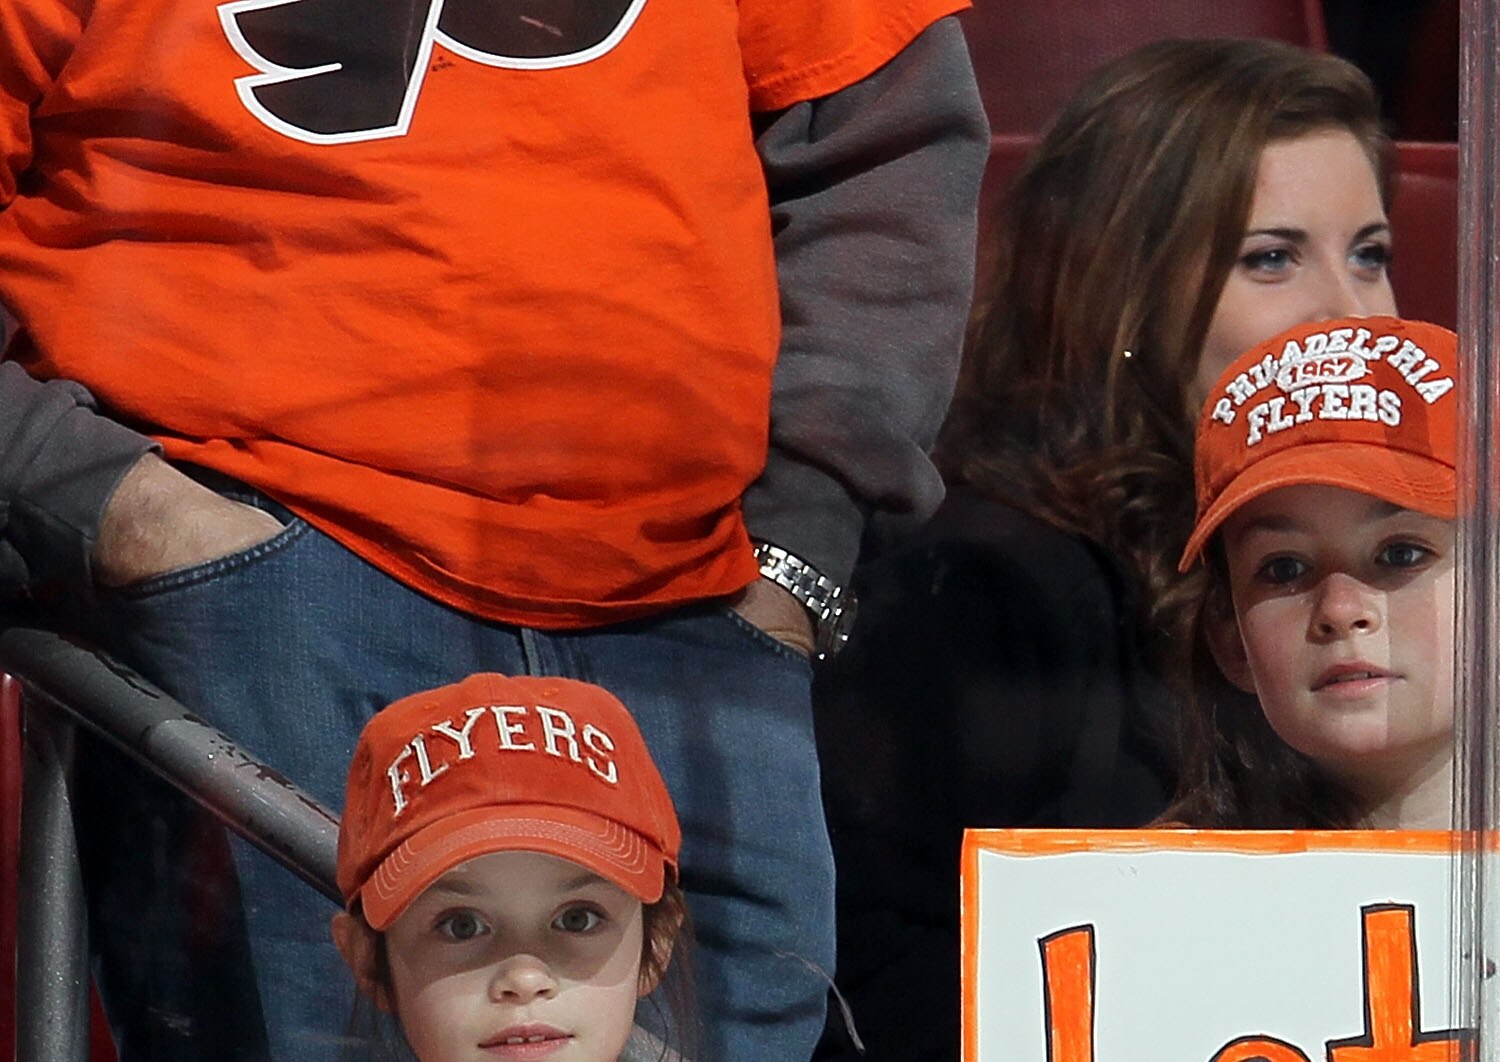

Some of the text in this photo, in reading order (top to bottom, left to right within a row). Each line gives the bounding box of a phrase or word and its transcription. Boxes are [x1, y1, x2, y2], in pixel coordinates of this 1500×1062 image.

[1210, 327, 1455, 425] PHILADELPHIA
[1246, 384, 1402, 446] FLYERS
[387, 704, 618, 818] FLYERS
